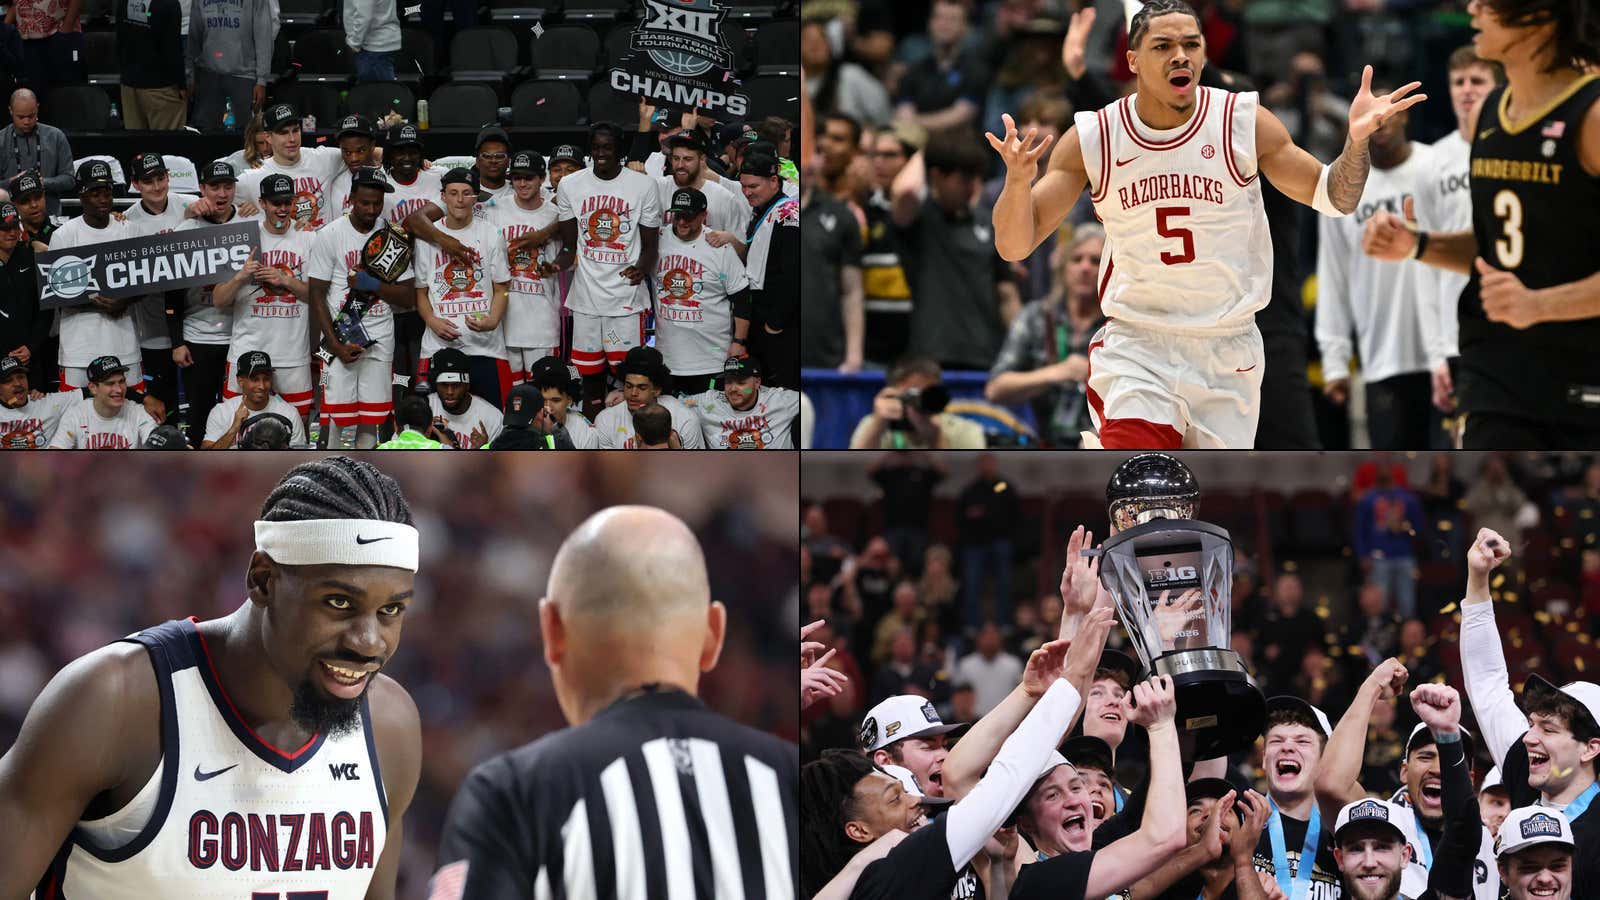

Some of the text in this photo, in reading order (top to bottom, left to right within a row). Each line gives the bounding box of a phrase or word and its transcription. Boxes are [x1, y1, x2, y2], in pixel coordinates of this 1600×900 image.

[207, 16, 240, 28] ROYALS
[645, 0, 718, 42] XII
[638, 40, 726, 63] TOURNAMENT
[640, 34, 722, 58] BASKETBALL
[645, 69, 713, 89] MEN'S BASKETBALL
[610, 69, 747, 116] CHAMPS
[1202, 146, 1214, 158] SEC
[1472, 158, 1563, 184] VANDERBILT
[1118, 174, 1223, 210] RAZORBACKS
[1440, 172, 1469, 196] LOC
[581, 195, 631, 219] ARIZONA
[1156, 207, 1195, 265] 5
[1494, 190, 1523, 268] 3
[104, 233, 249, 262] MEN'S BASKETBALL 2026
[105, 244, 251, 289] CHAMPS
[262, 249, 302, 272] RIZONA
[658, 255, 704, 280] ARIZONA
[252, 306, 301, 317] WILDCATS
[438, 300, 488, 313] WILDCATS
[86, 432, 130, 449] ARIZONA
[886, 721, 901, 738] P
[329, 763, 360, 781] WCC
[188, 809, 374, 872] GONZAGA
